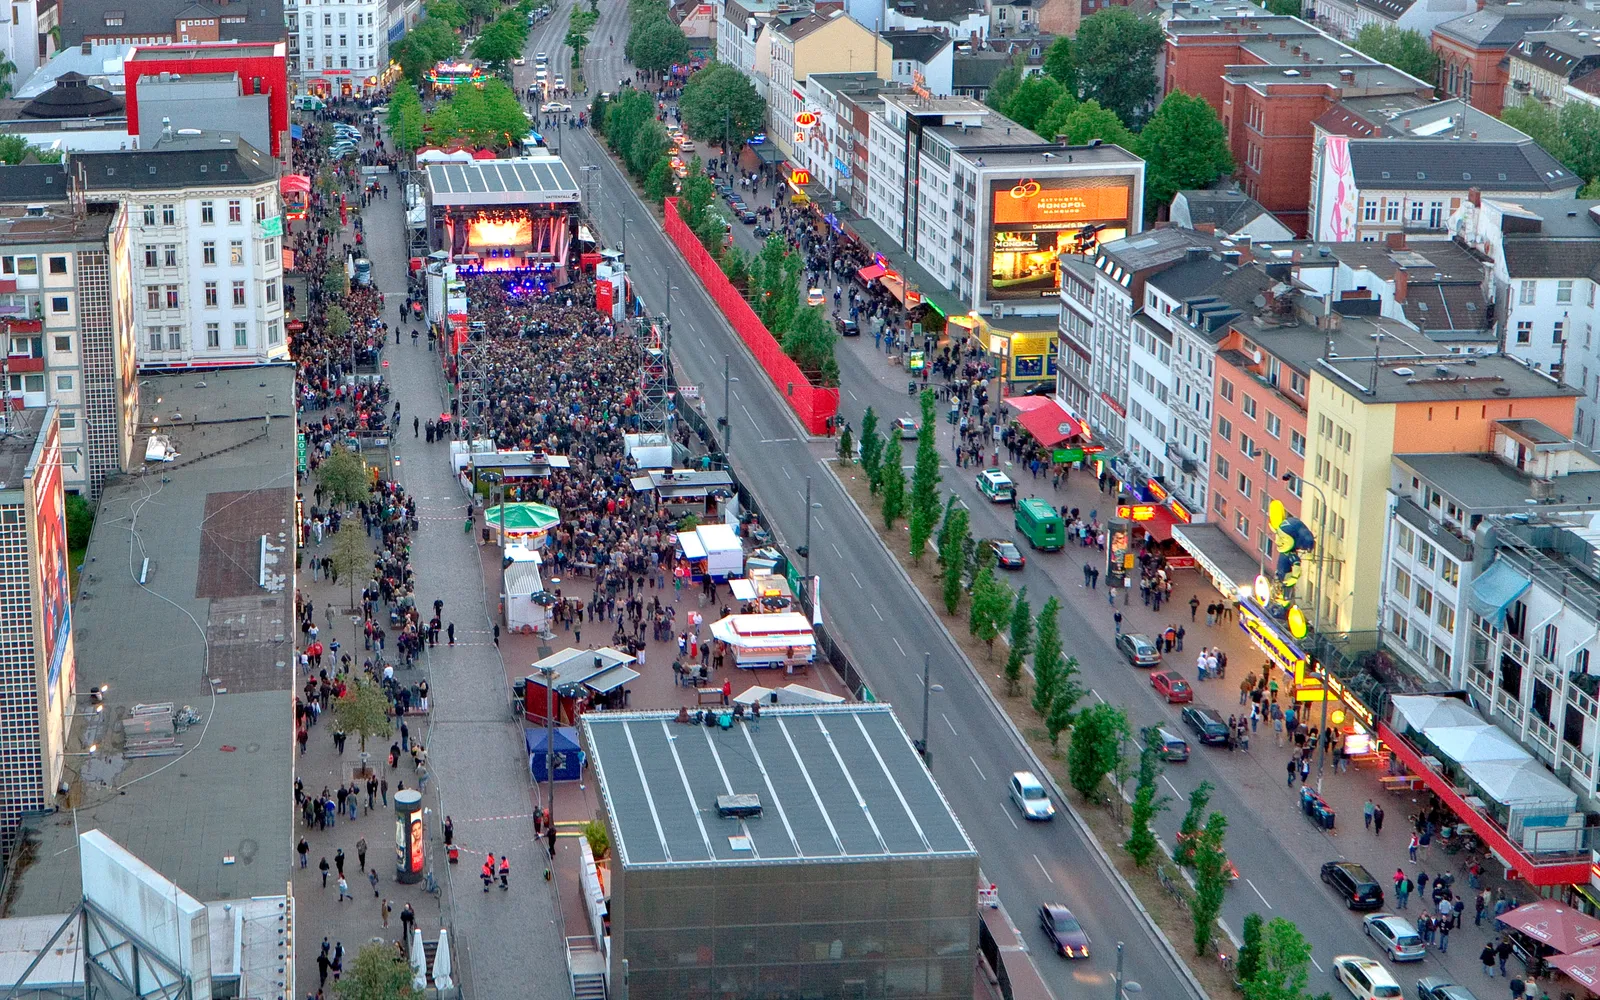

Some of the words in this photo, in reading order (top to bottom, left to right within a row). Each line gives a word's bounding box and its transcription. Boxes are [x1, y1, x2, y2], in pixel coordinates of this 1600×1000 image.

[1524, 925, 1548, 939] ASTRA
[1580, 932, 1599, 943] ASTRA
[1571, 968, 1593, 984] ASTRA
